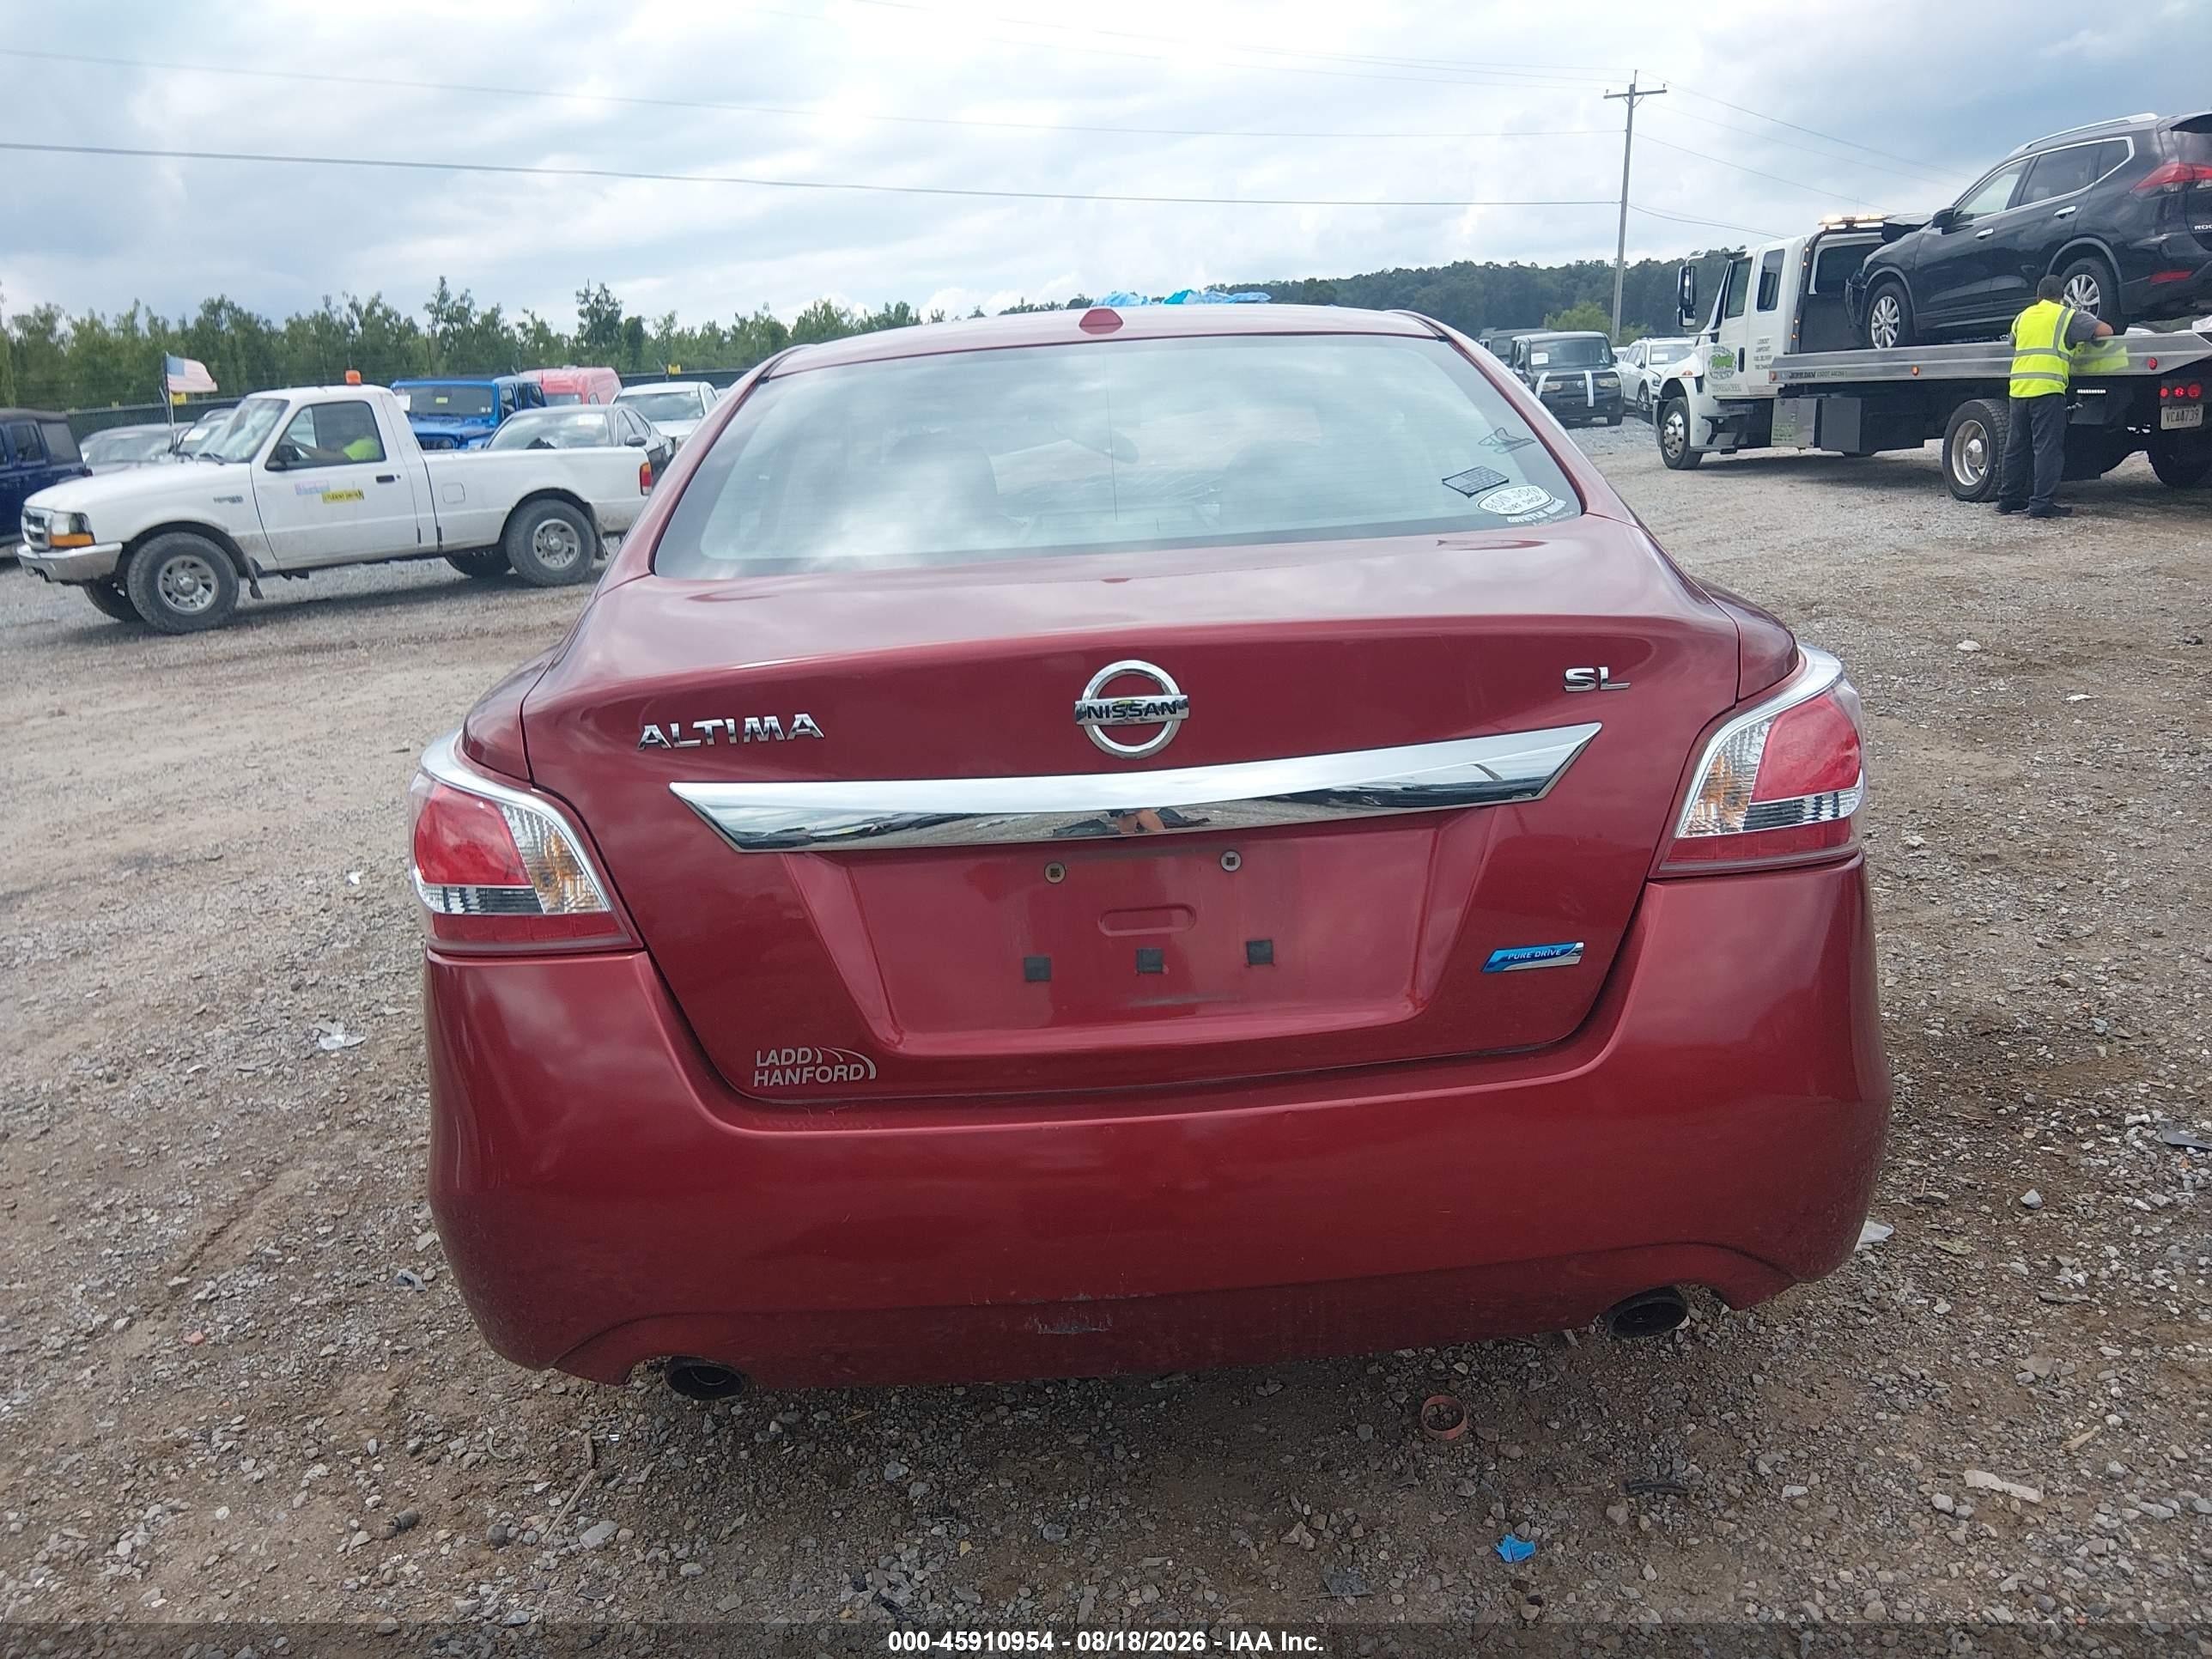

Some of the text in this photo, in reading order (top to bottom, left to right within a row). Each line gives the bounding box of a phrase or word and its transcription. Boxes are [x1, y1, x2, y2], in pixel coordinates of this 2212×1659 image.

[1565, 666, 1631, 691] SL
[1086, 701, 1178, 719] NISSAN
[638, 713, 824, 750] ALTIMA
[1507, 948, 1562, 960] PURE DRIVE
[756, 1047, 812, 1066] LADD
[753, 1064, 865, 1087] HANFORD
